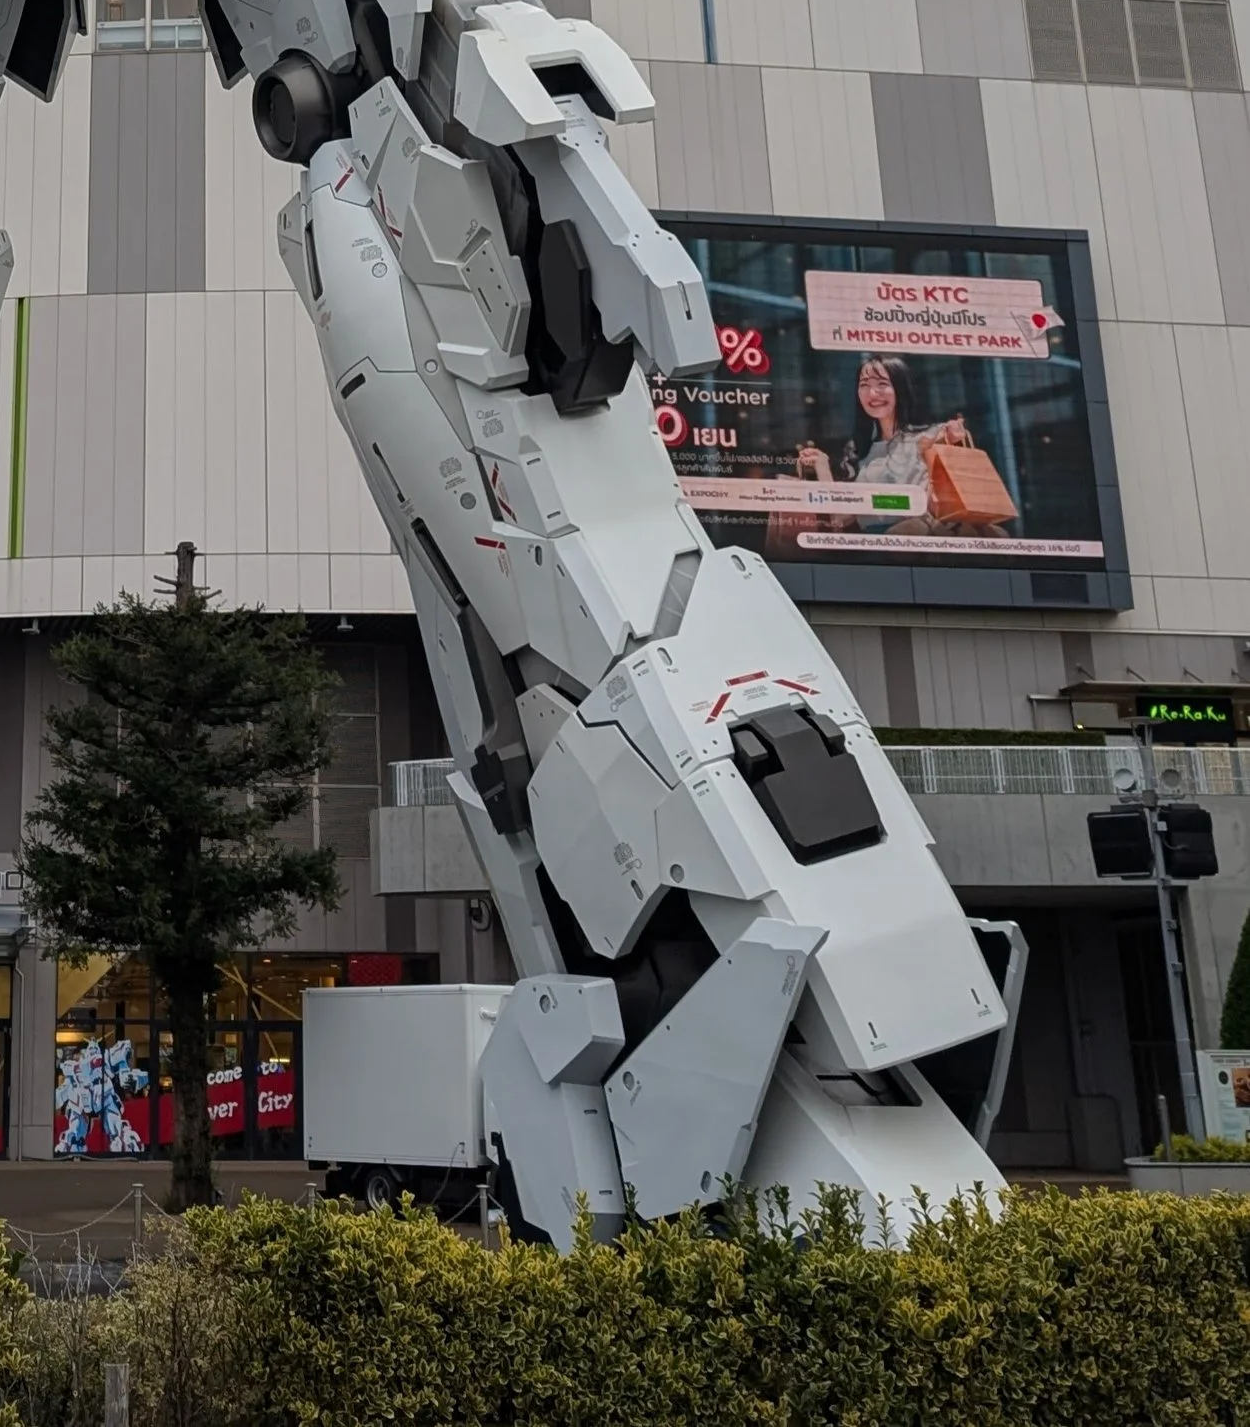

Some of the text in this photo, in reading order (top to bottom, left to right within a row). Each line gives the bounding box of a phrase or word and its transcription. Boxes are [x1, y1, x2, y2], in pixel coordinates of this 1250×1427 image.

[877, 282, 969, 304] บัตร KTC
[847, 330, 903, 343] MITSUI
[908, 332, 973, 346] OUTLET
[978, 336, 1022, 349] PARK
[684, 386, 770, 405] Voucher
[693, 427, 738, 447] เยน
[206, 1061, 278, 1085] come to
[207, 1091, 293, 1120] ver City
